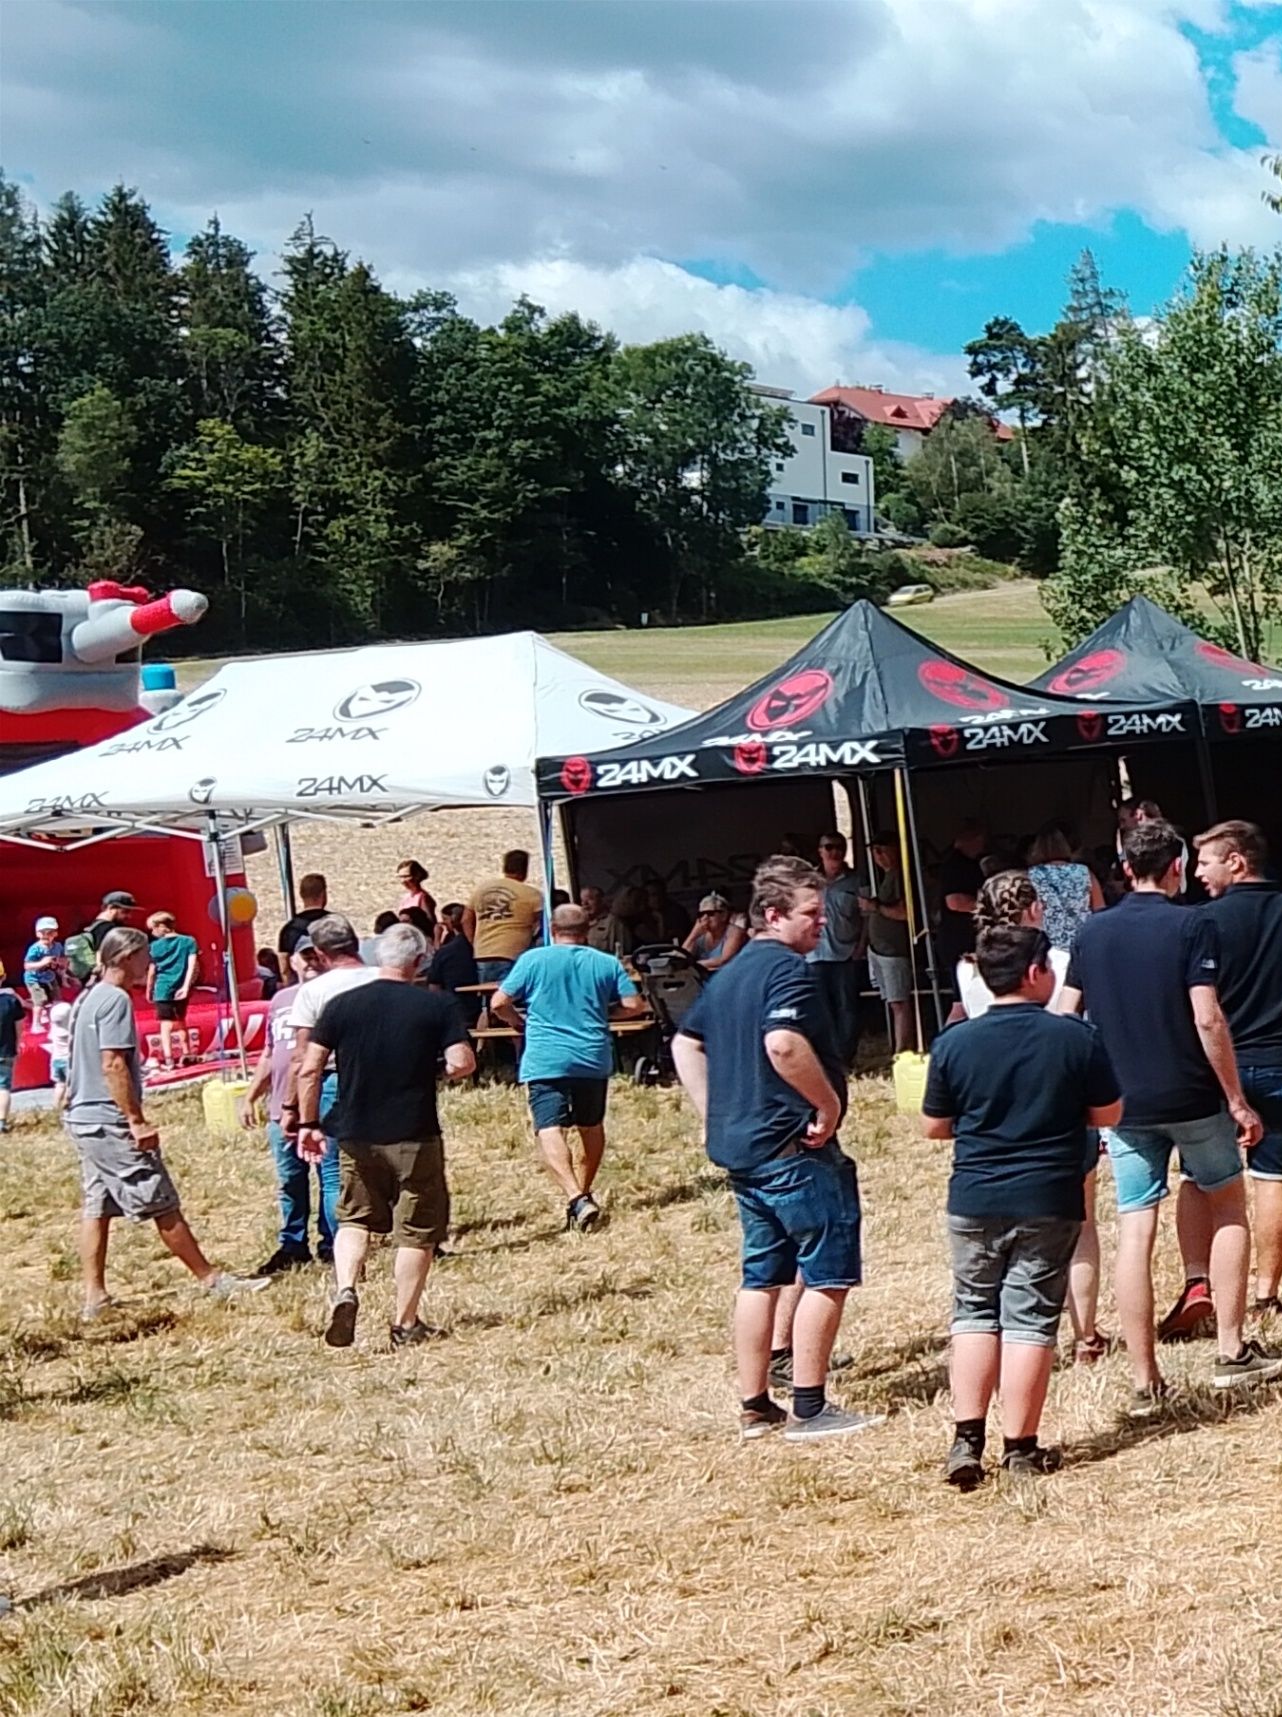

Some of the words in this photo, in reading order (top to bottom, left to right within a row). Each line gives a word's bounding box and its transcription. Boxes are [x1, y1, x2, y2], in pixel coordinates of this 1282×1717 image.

[286, 727, 389, 743] 24MX
[963, 721, 1050, 750] 24MX
[1107, 713, 1186, 736] 24MX
[772, 740, 881, 769] 24MX
[596, 754, 699, 788] 24MX
[296, 774, 390, 797] 24MX
[24, 791, 109, 813] 24MX
